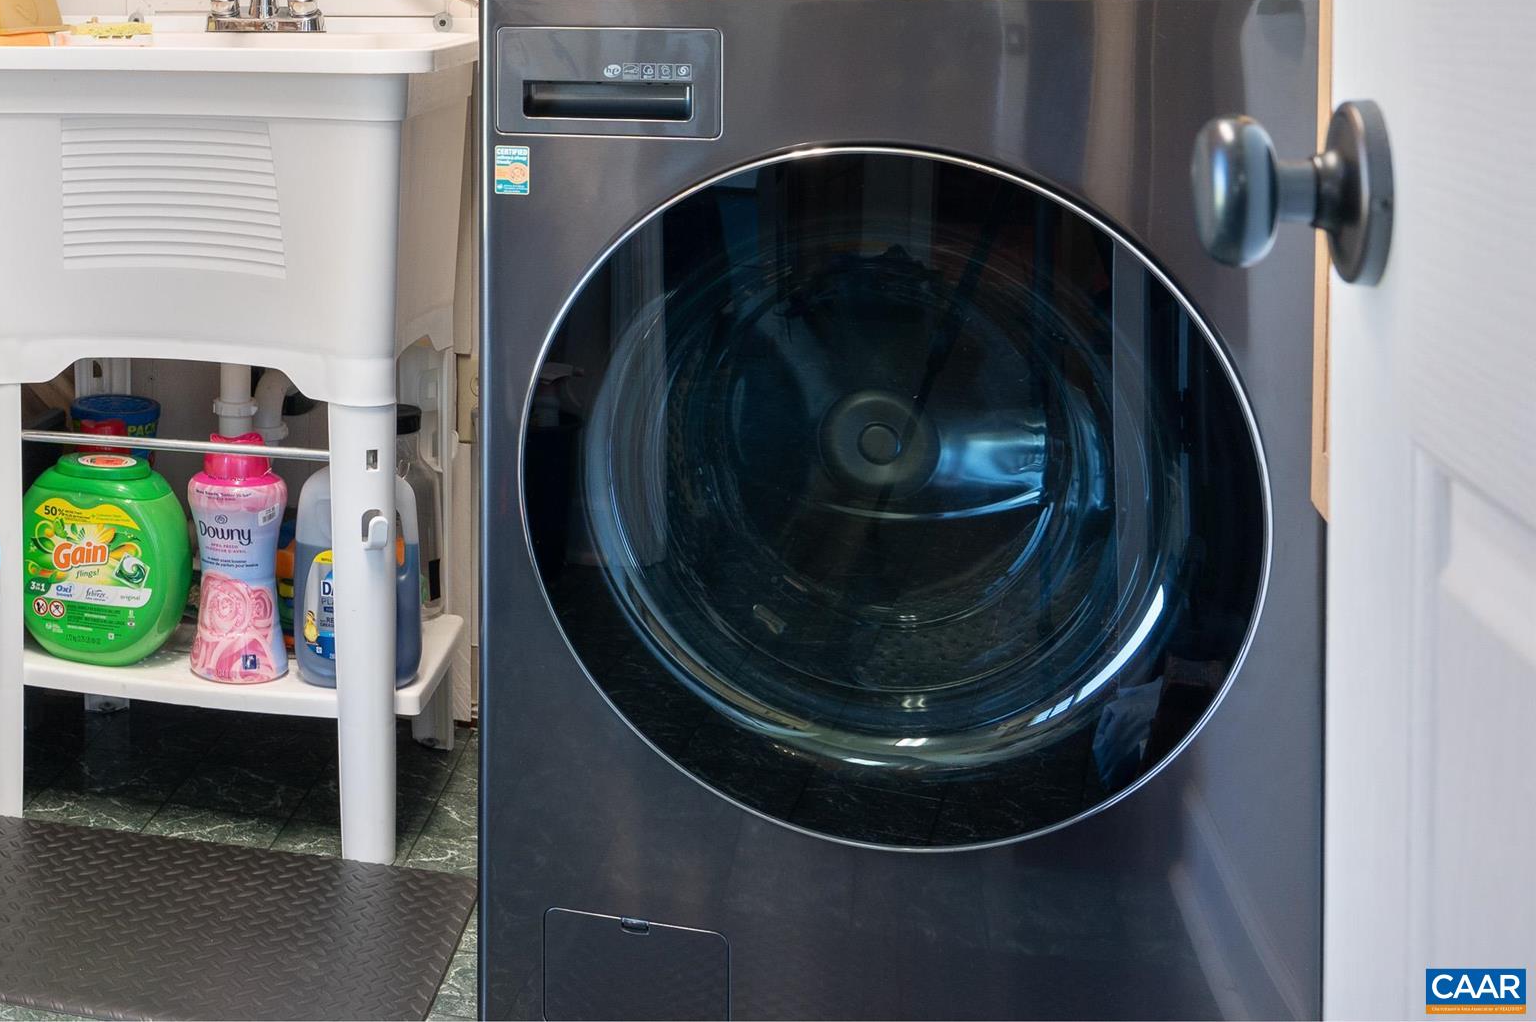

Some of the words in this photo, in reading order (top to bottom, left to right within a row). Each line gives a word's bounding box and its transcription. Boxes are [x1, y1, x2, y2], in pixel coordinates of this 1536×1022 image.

[199, 520, 252, 546] Downy
[54, 541, 107, 569] Gain
[56, 584, 72, 593] Oxi
